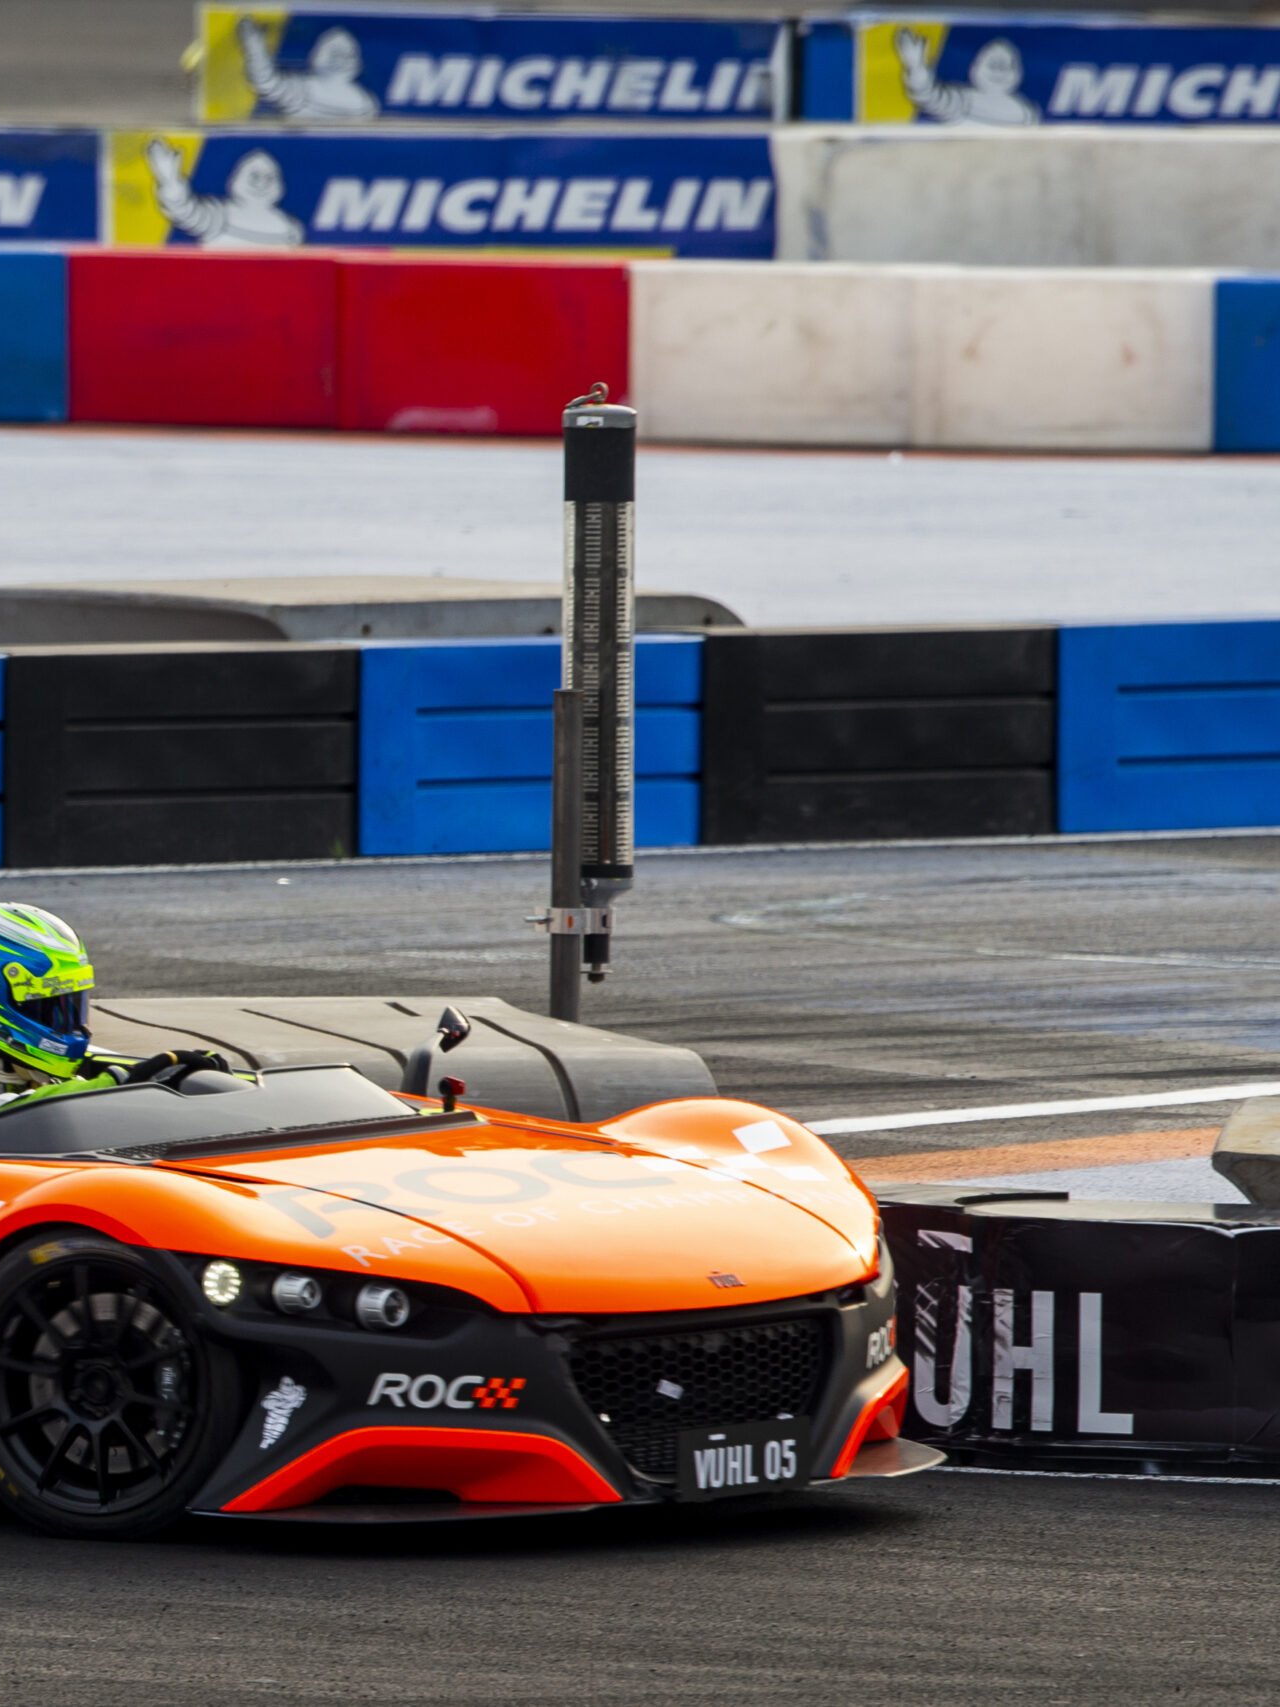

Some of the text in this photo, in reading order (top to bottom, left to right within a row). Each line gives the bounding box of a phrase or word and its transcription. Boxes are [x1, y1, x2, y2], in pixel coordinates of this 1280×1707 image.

[312, 179, 769, 235] MICHELIN
[256, 1150, 675, 1239] ROC
[341, 1220, 484, 1267] RACE
[491, 1205, 561, 1230] OF
[367, 1372, 483, 1410] ROC
[764, 1439, 797, 1481] 05
